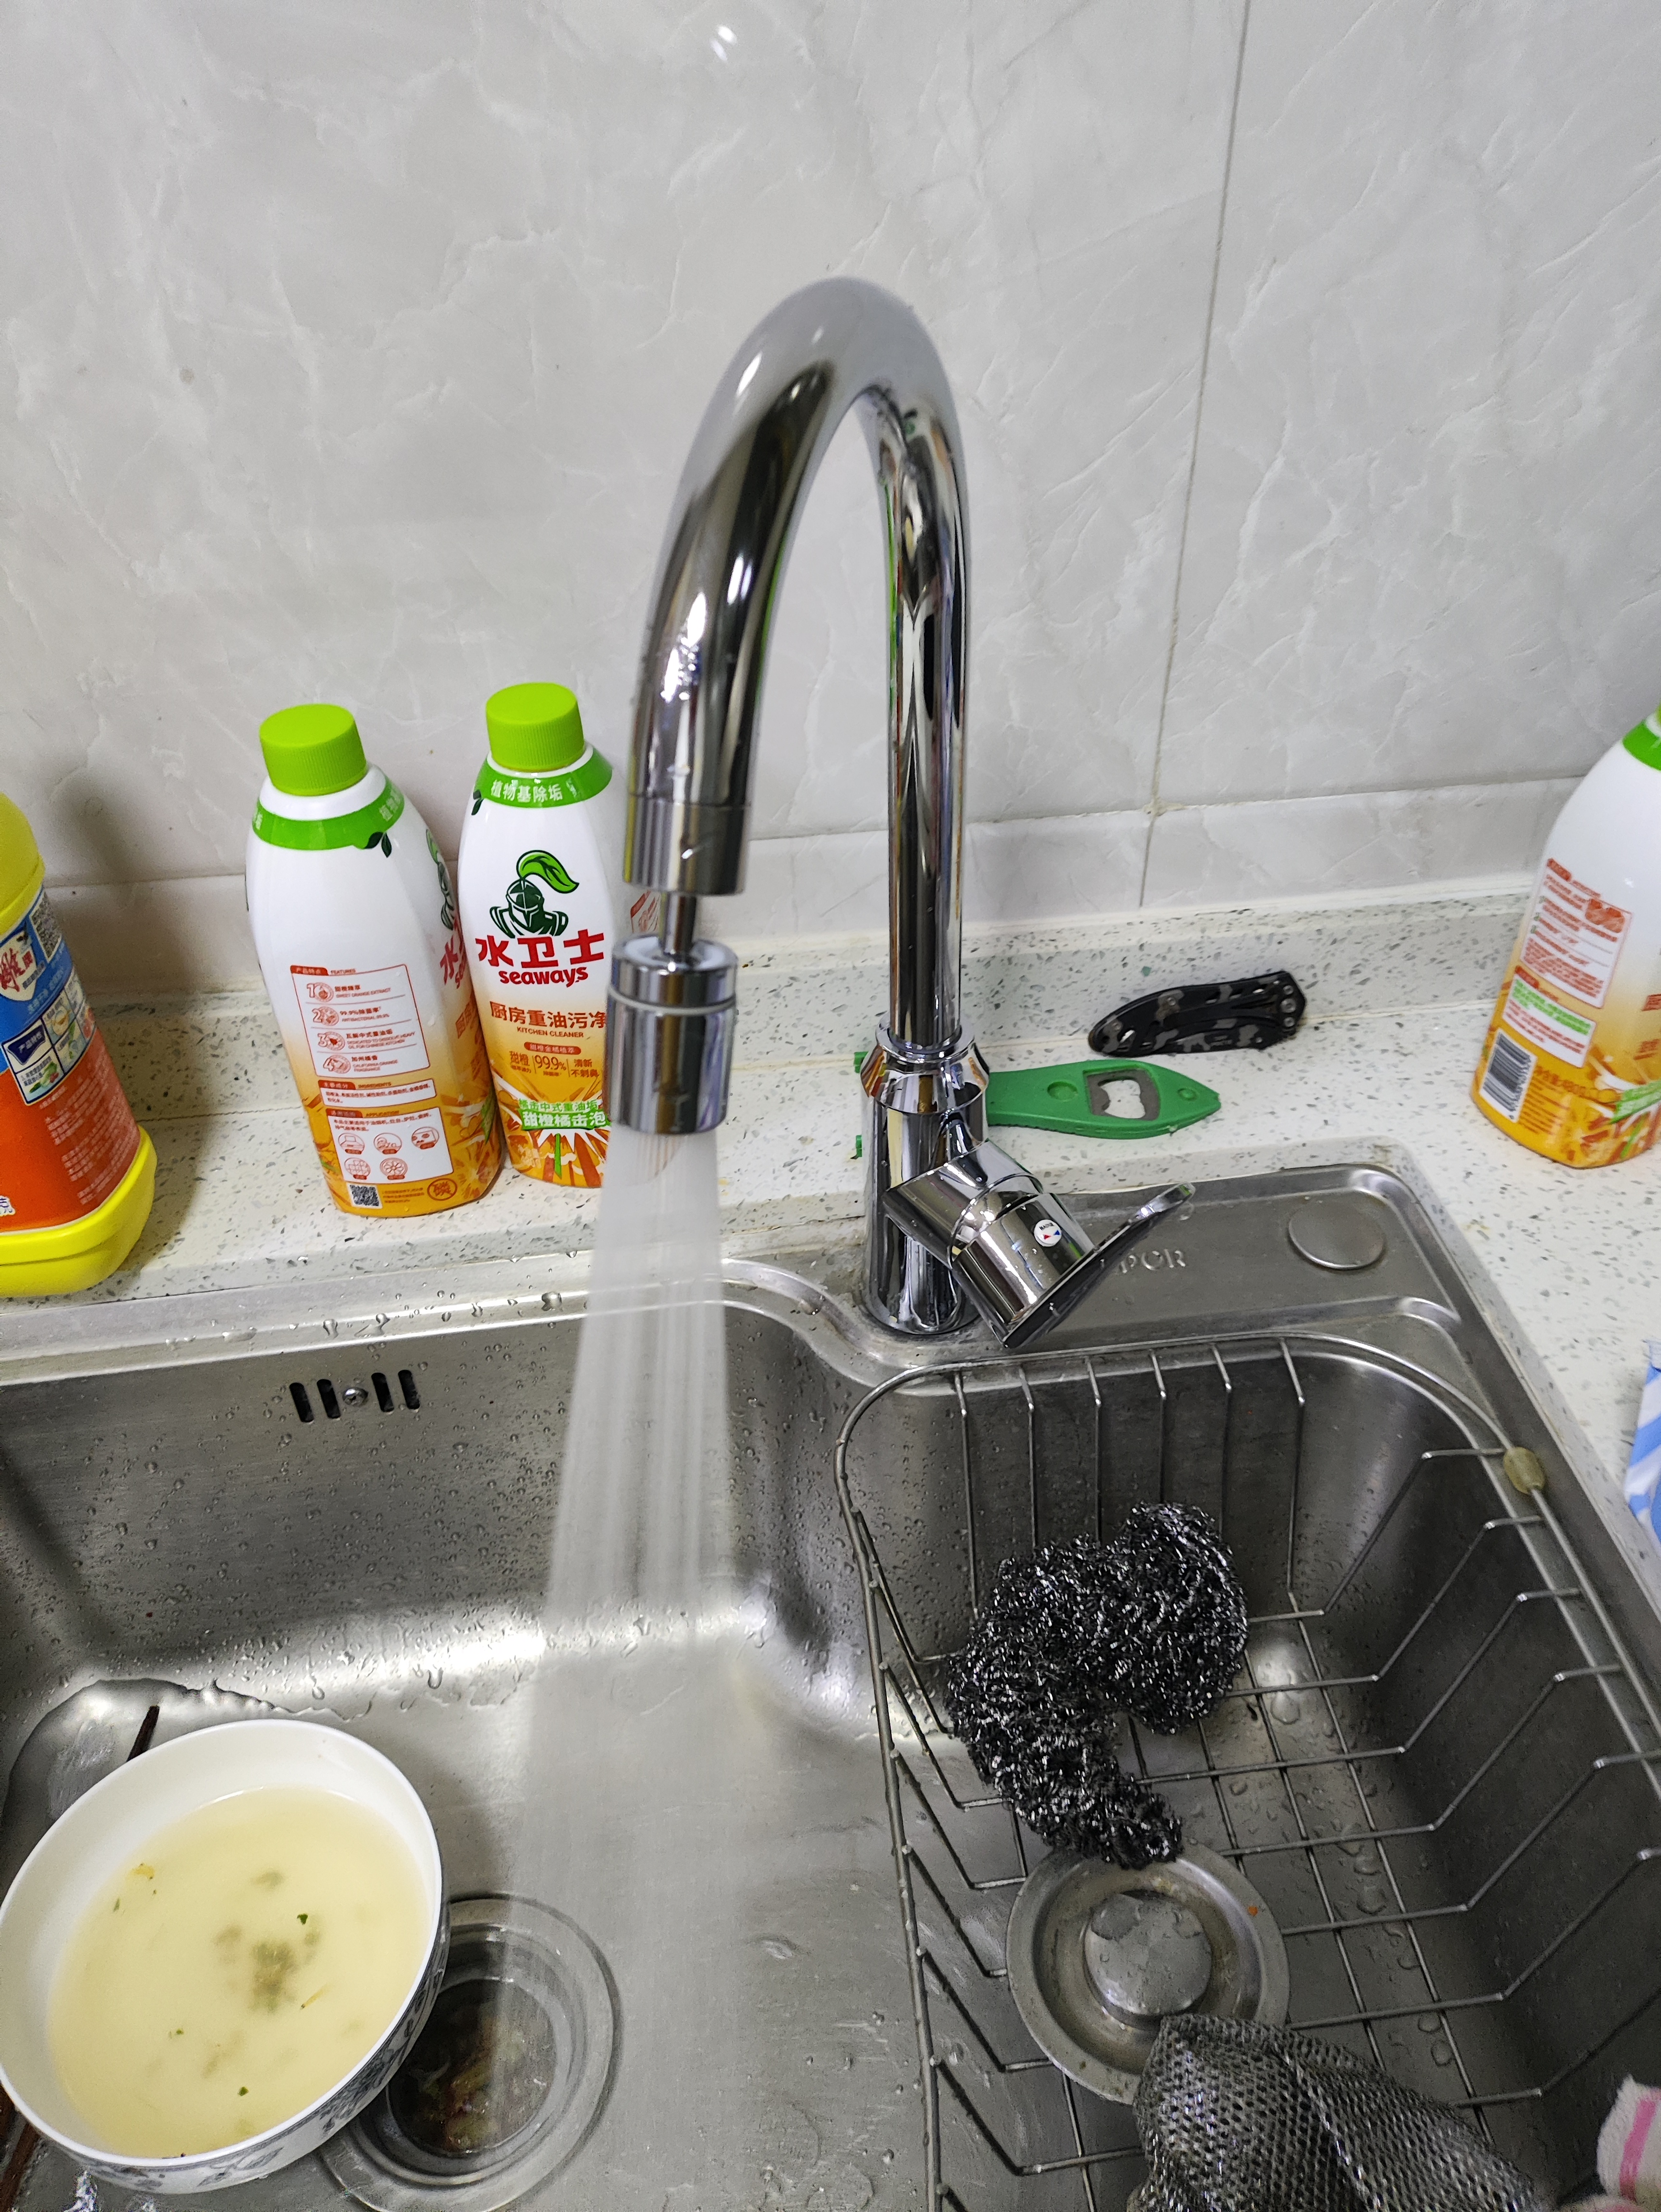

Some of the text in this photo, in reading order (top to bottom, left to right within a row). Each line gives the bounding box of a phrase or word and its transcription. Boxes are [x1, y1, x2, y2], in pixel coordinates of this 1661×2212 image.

[491, 779, 563, 803] 植物基除垢
[475, 929, 604, 969] 水卫士
[498, 967, 588, 988] seaways
[489, 1001, 606, 1029] 厨房重油污净
[517, 1027, 584, 1038] KITCHEN CLEANER
[534, 1054, 567, 1071] 99.9%
